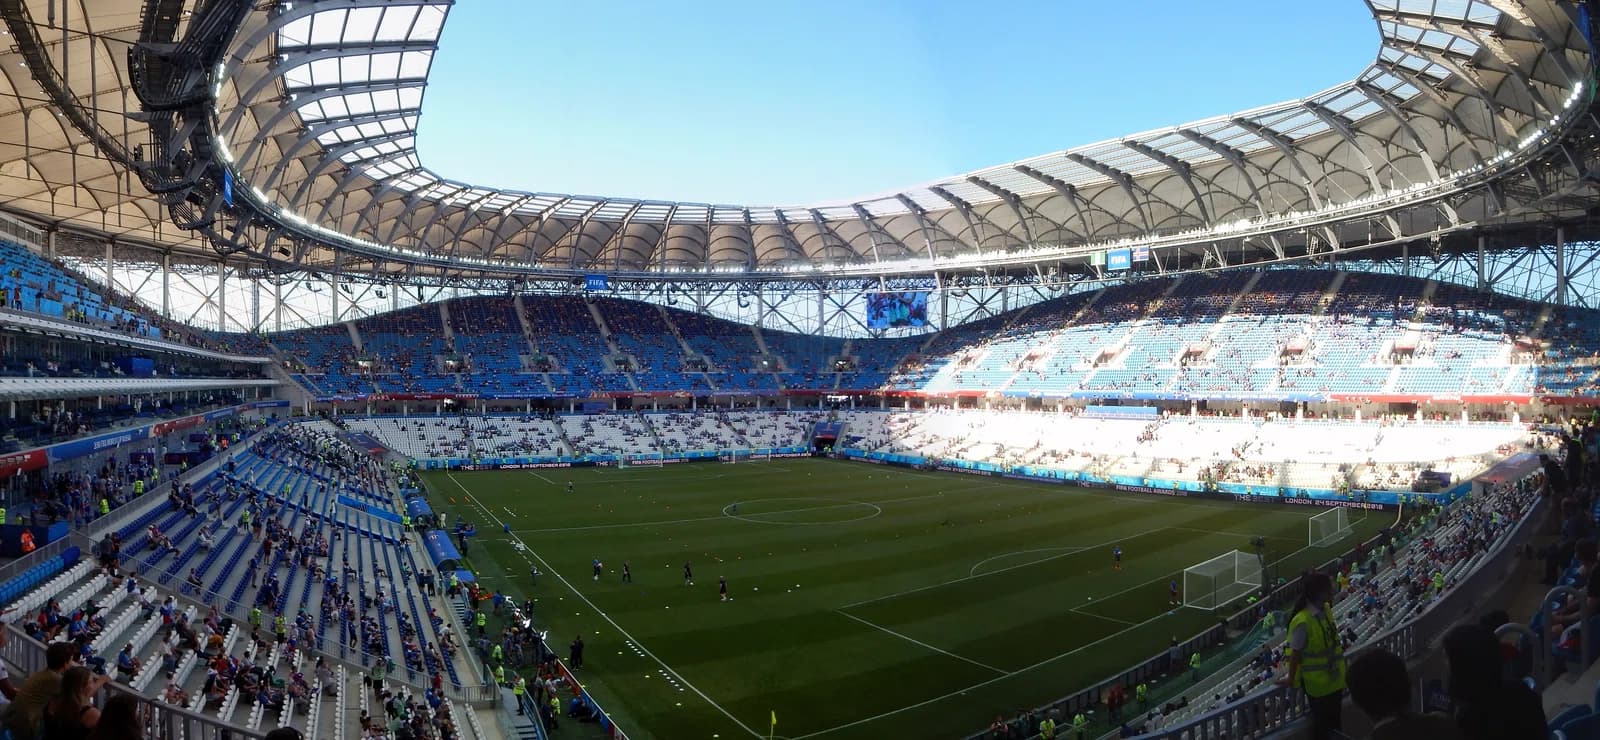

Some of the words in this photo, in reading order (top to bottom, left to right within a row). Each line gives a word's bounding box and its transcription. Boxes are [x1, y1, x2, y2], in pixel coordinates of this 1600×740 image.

[1111, 256, 1126, 264] FIFA
[1128, 486, 1153, 494] FOOTBALL
[1234, 494, 1251, 502] THE
[1285, 497, 1313, 505] LONDON
[1325, 500, 1366, 509] SEPTEMBER
